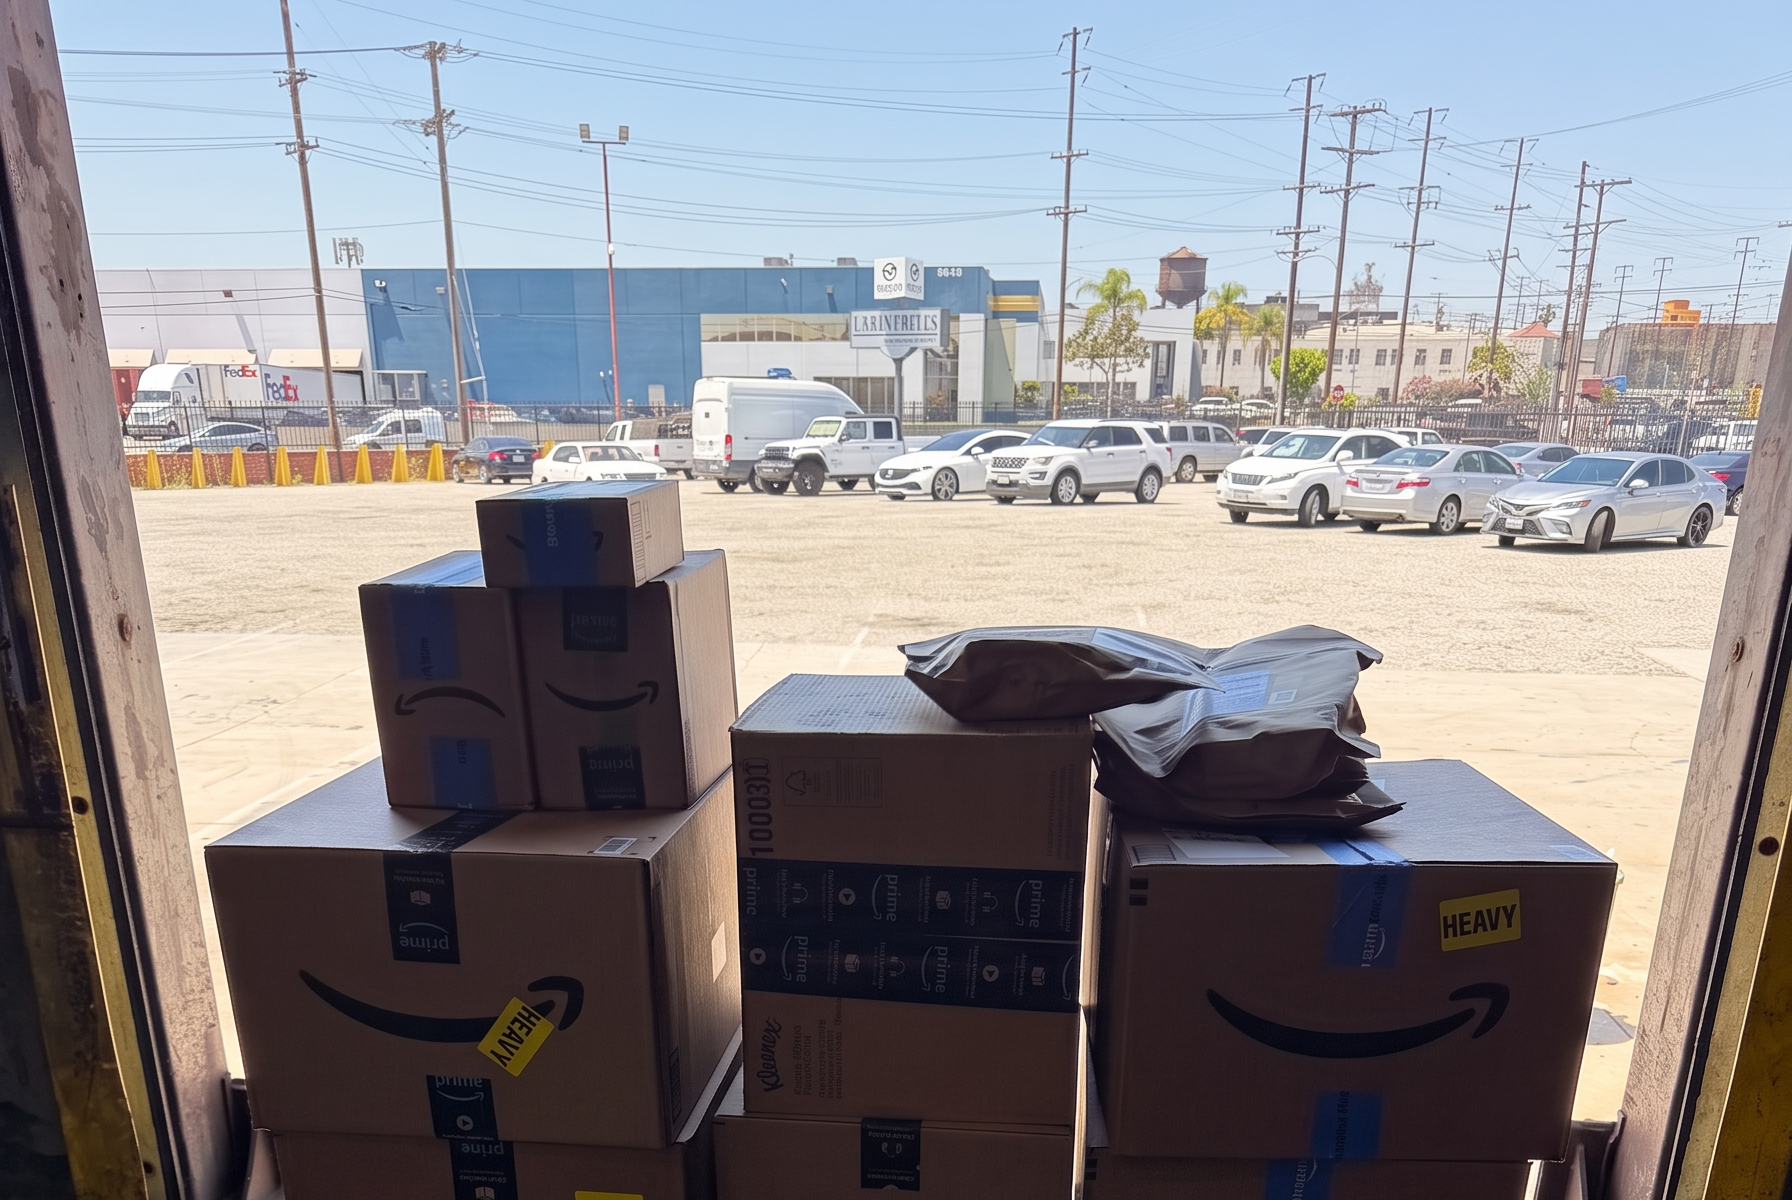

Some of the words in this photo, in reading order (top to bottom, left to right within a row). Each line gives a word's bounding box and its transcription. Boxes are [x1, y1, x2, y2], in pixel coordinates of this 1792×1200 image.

[224, 365, 258, 378] FedEx
[742, 867, 760, 916] prime
[884, 874, 902, 922] prime
[1028, 879, 1046, 928] prime
[399, 935, 450, 952] prime
[1443, 904, 1517, 939] HEAVY
[794, 935, 811, 983] prime
[934, 946, 951, 993] prime
[490, 1005, 541, 1067] HEAVY
